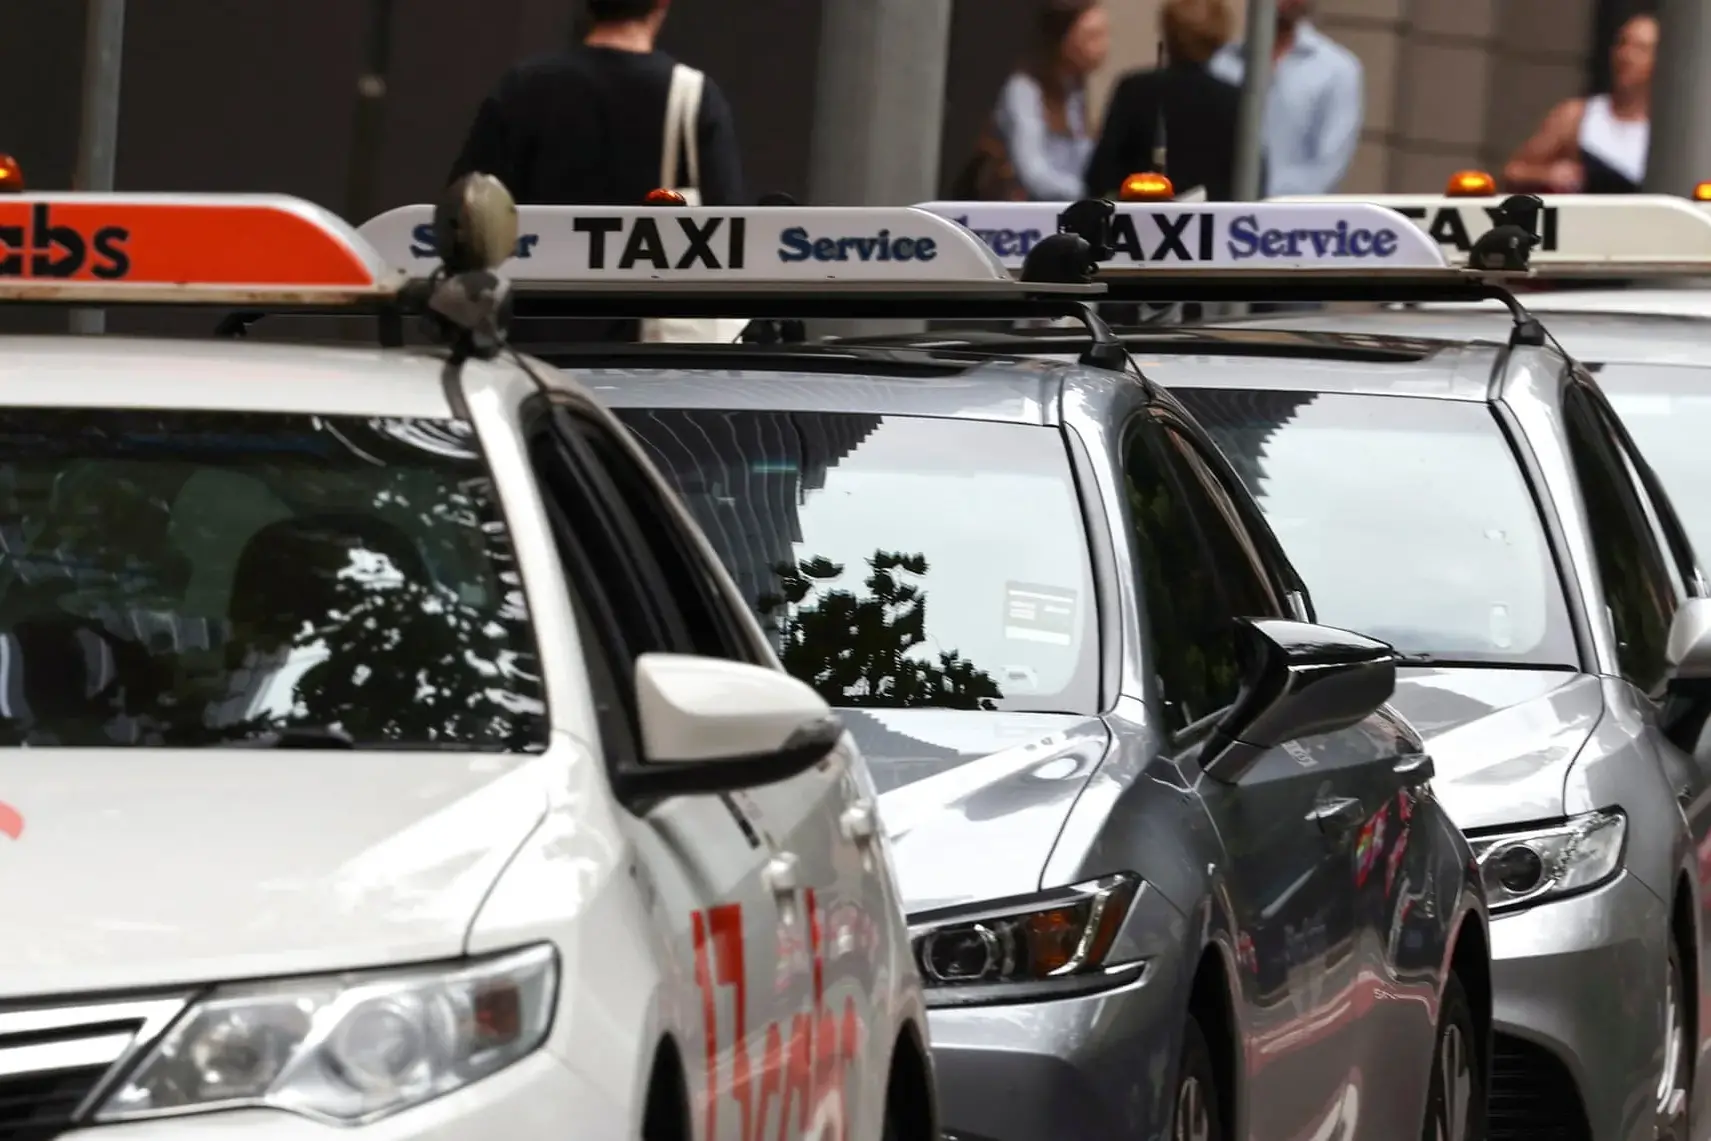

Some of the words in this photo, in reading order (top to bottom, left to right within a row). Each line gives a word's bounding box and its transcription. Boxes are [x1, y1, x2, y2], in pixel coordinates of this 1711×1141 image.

[572, 216, 746, 270] TAXI
[778, 226, 937, 263] Service
[1057, 213, 1214, 261] AXI
[1227, 214, 1398, 260] Service
